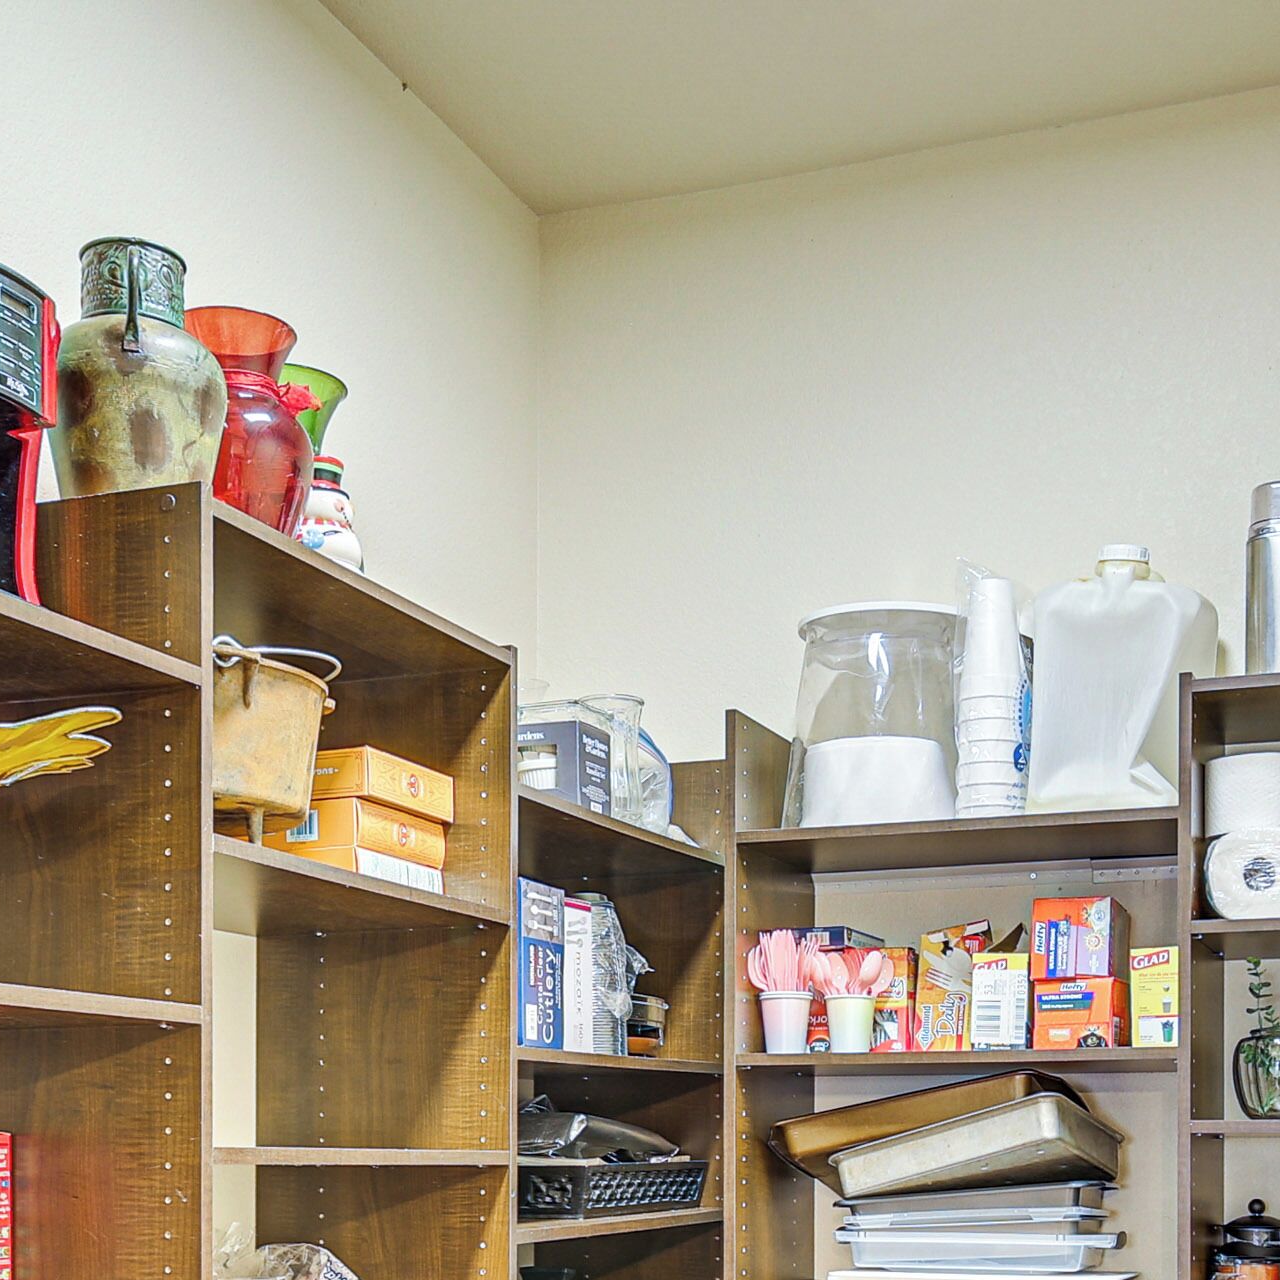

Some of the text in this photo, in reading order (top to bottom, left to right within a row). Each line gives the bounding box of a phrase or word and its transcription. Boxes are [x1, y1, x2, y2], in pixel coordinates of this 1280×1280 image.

[1035, 924, 1046, 953] Hefty
[1133, 952, 1169, 969] GLAD
[542, 949, 557, 1044] Cutlery
[1062, 983, 1085, 991] Hefty
[921, 1006, 931, 1042] diamond
[935, 991, 967, 1036] Daily
